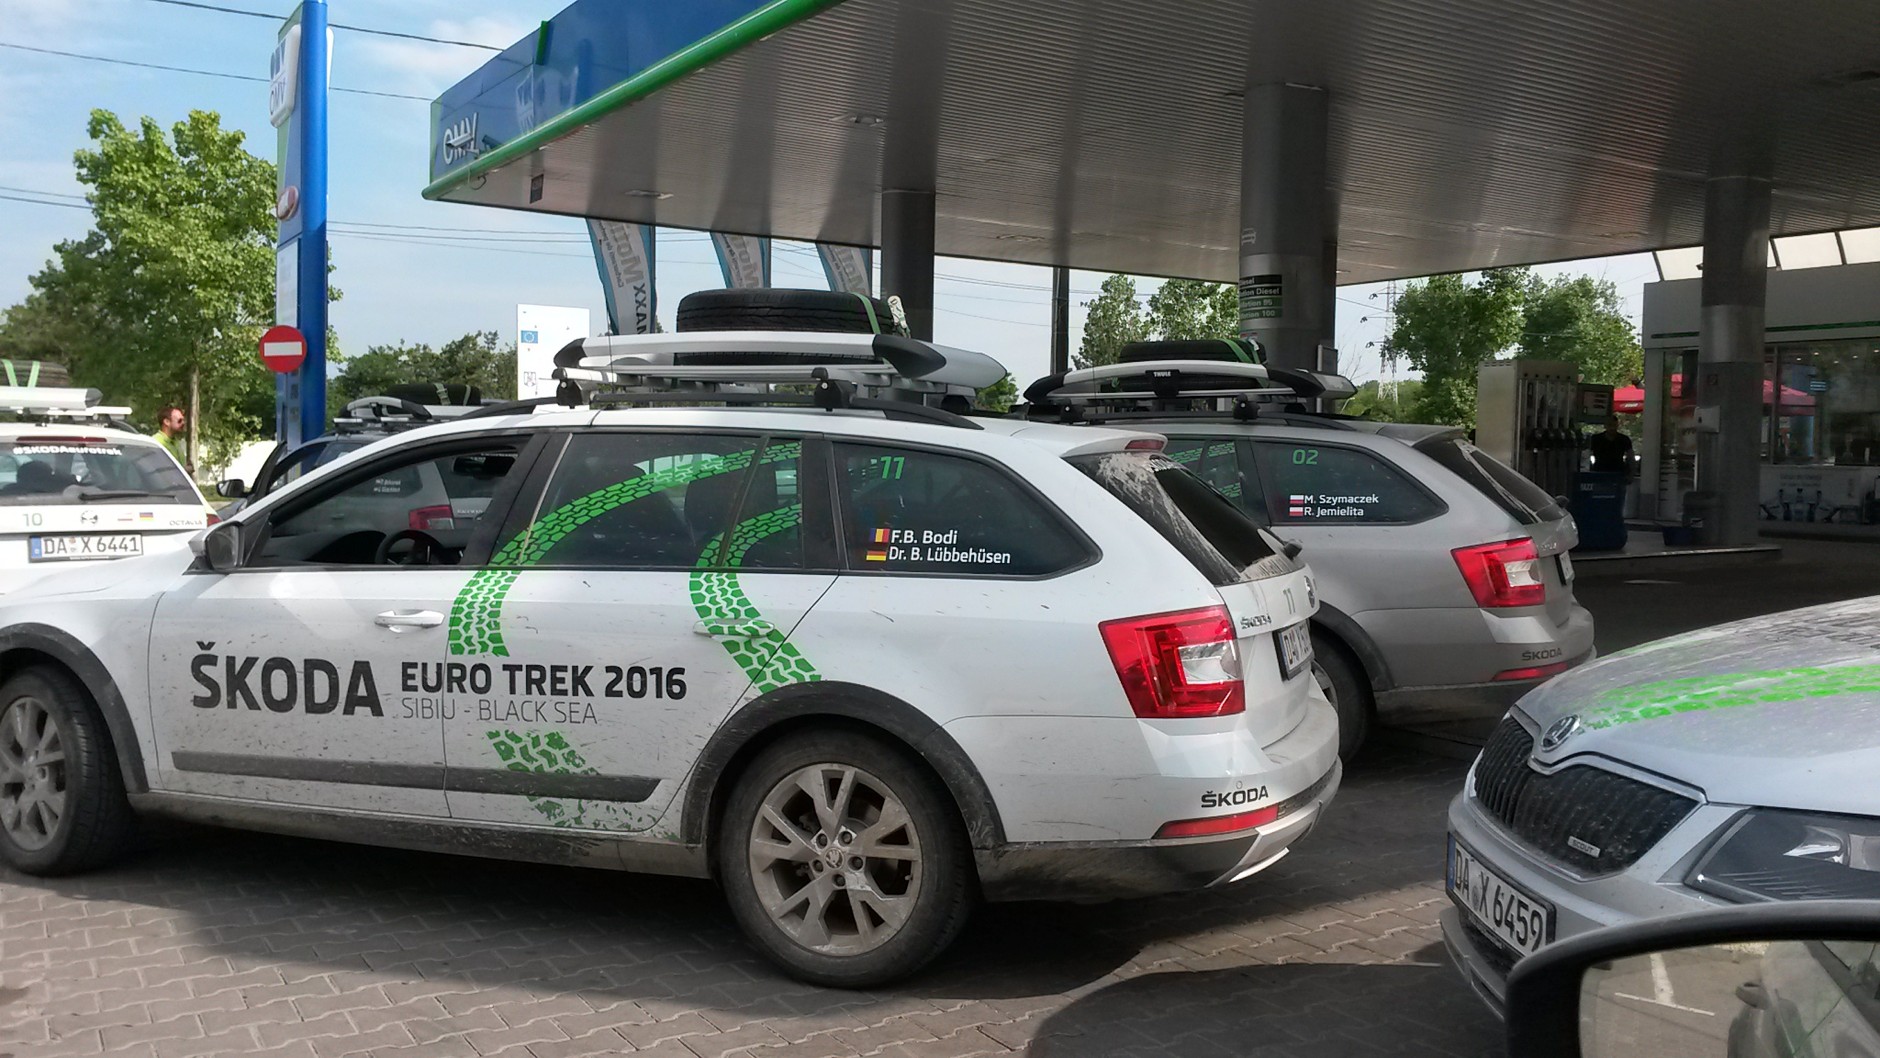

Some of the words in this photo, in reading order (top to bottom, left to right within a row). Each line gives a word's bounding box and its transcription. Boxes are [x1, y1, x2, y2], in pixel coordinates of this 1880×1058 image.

[1256, 287, 1280, 297] Diesel
[1292, 449, 1319, 464] 02
[880, 456, 905, 479] 11
[1304, 494, 1317, 504] M.
[1319, 493, 1379, 506] Szymaczek
[23, 513, 43, 526] 10
[1304, 507, 1315, 516] R.
[1316, 506, 1364, 517] Jemielita
[44, 536, 67, 555] DA
[81, 537, 92, 553] X
[96, 536, 140, 553] 6441
[891, 530, 918, 544] F.B.
[922, 530, 958, 544] Bodi
[889, 546, 907, 561] Dr.
[910, 548, 923, 561] B.
[926, 548, 1011, 564] Lübbehüsen
[190, 641, 385, 717] ŠKODA
[401, 662, 491, 695] EURO
[502, 664, 595, 698] TREK
[604, 666, 687, 700] 2016
[402, 697, 456, 719] SIBIU
[479, 700, 547, 723] BLACK
[554, 702, 598, 725] SEA
[1201, 785, 1269, 808] ŠKODA
[1572, 839, 1595, 854] SCOUT
[1455, 848, 1470, 901] DA
[1492, 884, 1543, 953] 6459
